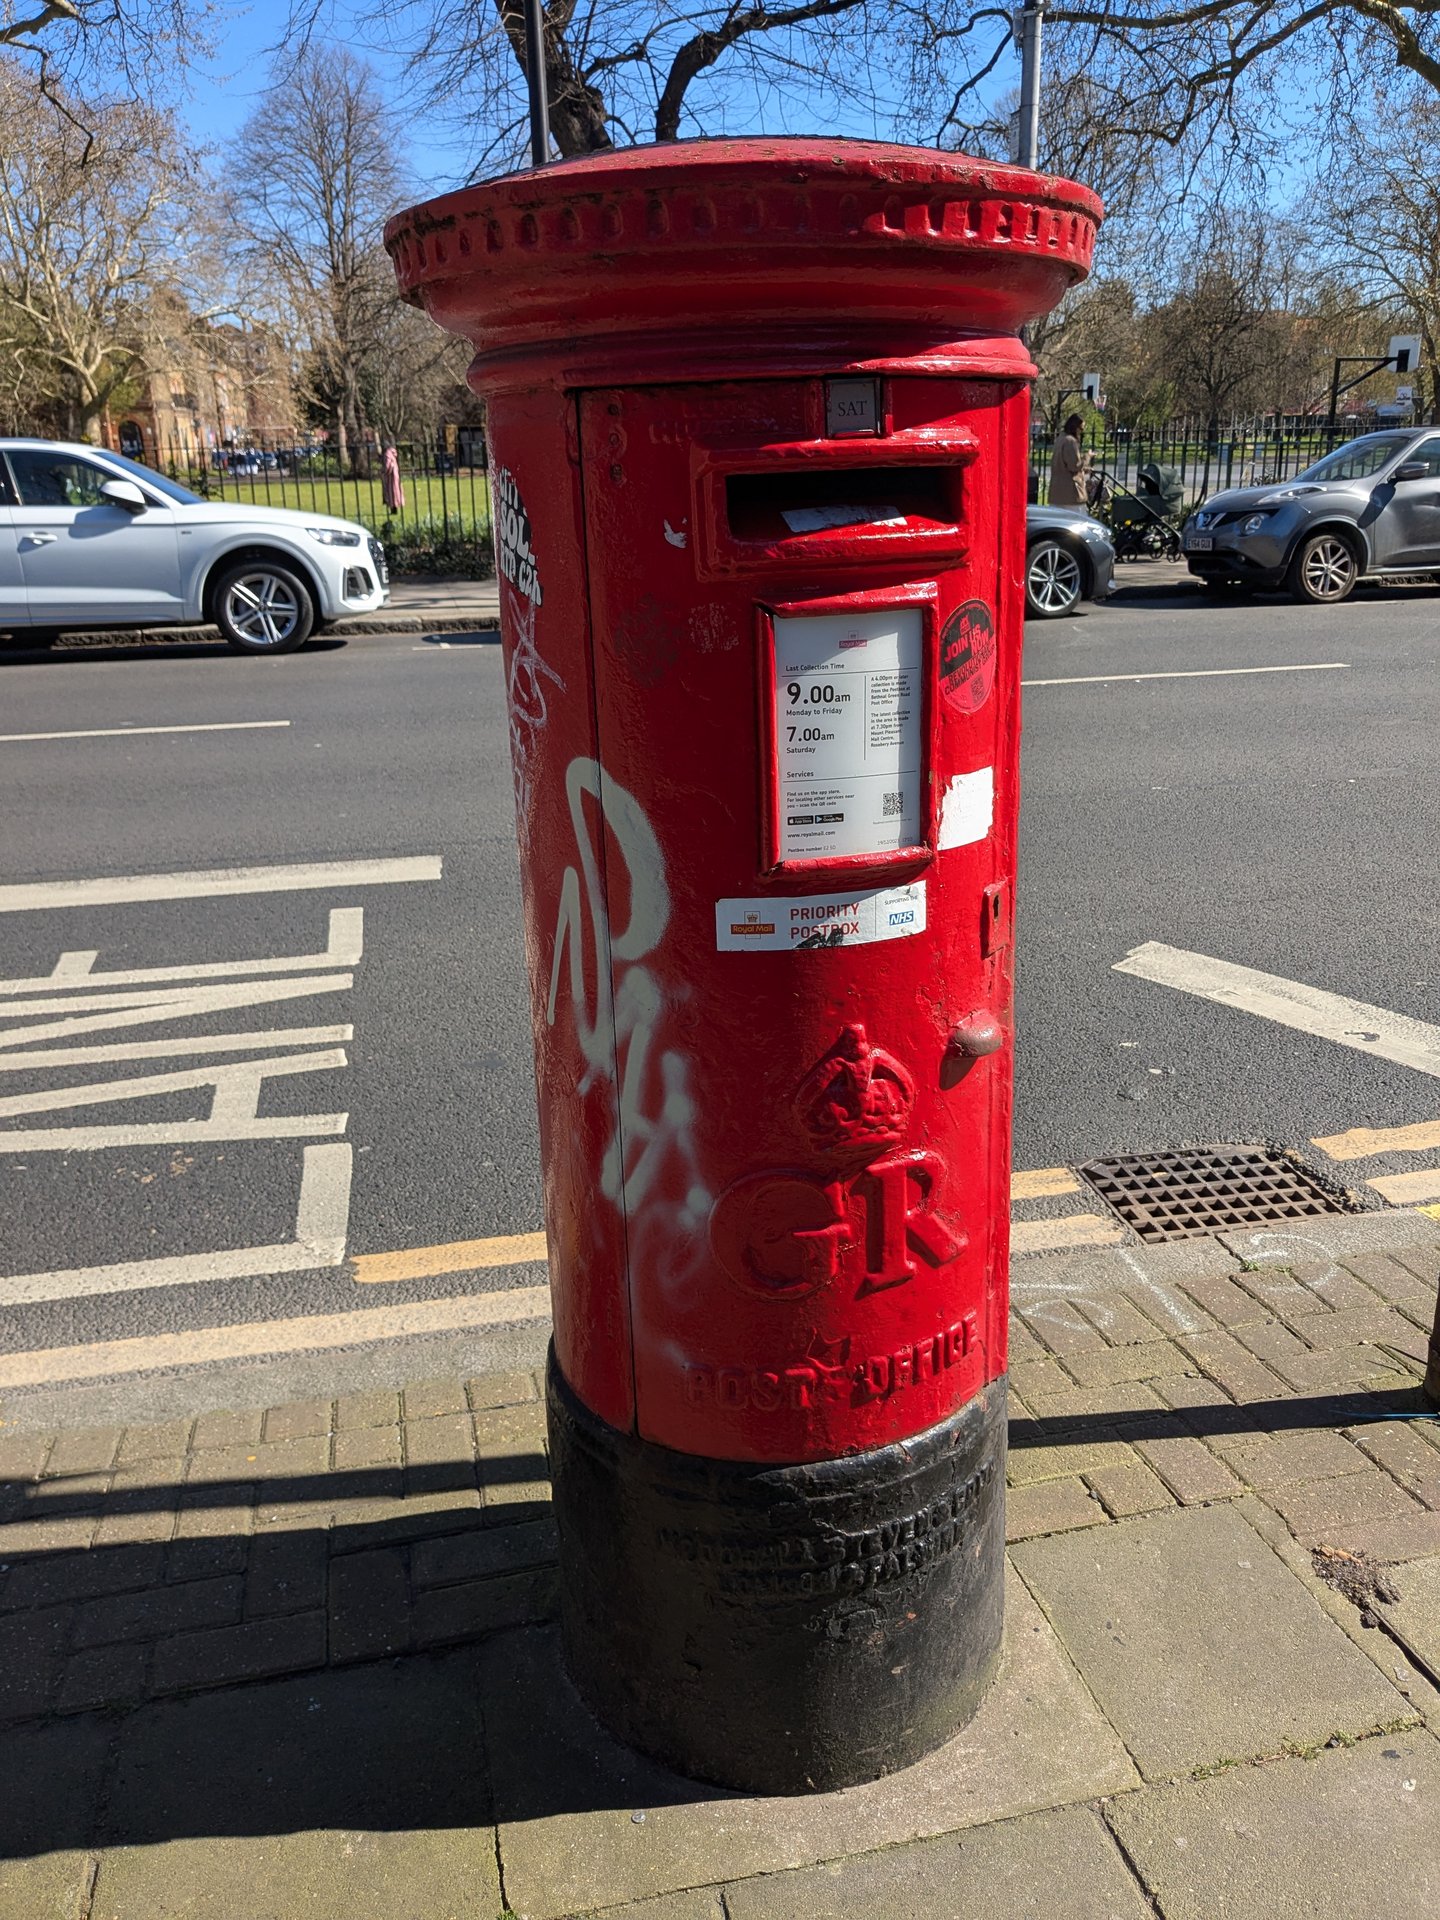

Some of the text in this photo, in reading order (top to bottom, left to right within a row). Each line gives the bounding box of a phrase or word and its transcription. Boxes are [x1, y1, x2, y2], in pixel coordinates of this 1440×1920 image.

[838, 401, 867, 417] SAT
[944, 633, 970, 662] JOIN
[787, 682, 851, 705] 9.00am
[786, 709, 812, 717] Monday
[822, 707, 843, 715] Friday
[786, 726, 835, 742] 7.00am
[786, 746, 816, 754] Saturday
[884, 897, 909, 906] SUPPORTING
[790, 903, 860, 920] PRIORITY
[891, 912, 913, 924] NHS
[686, 1309, 980, 1411] POST OFFICE
